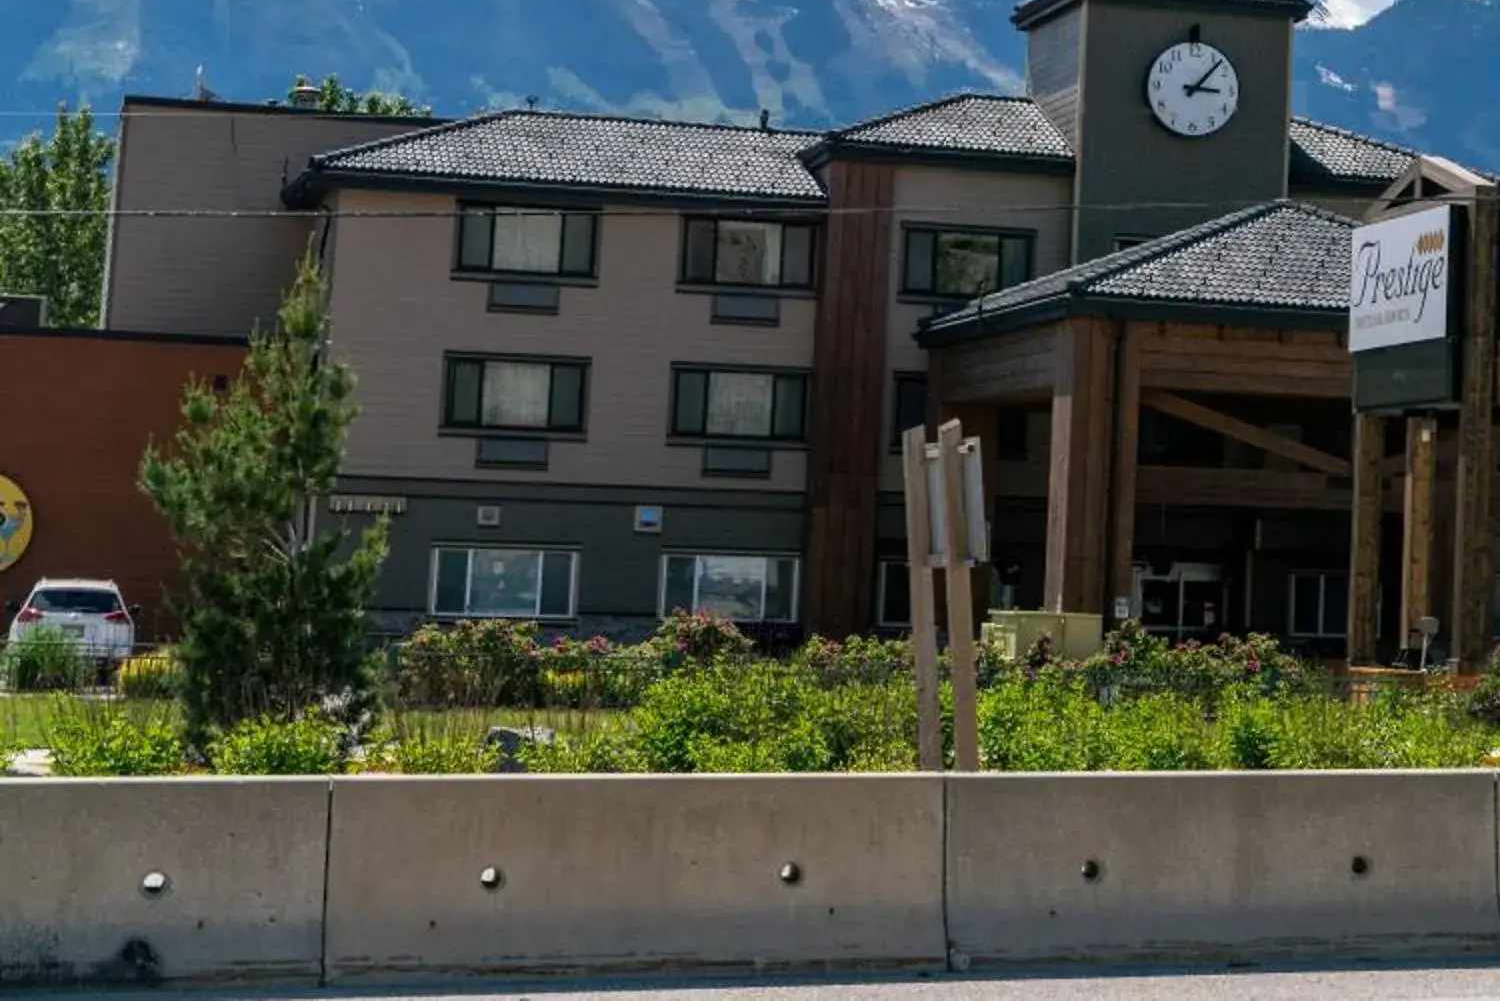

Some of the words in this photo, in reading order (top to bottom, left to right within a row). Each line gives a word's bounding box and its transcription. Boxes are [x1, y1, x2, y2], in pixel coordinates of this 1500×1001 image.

[1171, 50, 1182, 61] 11
[1189, 44, 1202, 57] 12
[1159, 62, 1173, 74] 10
[1352, 239, 1446, 323] Prestige
